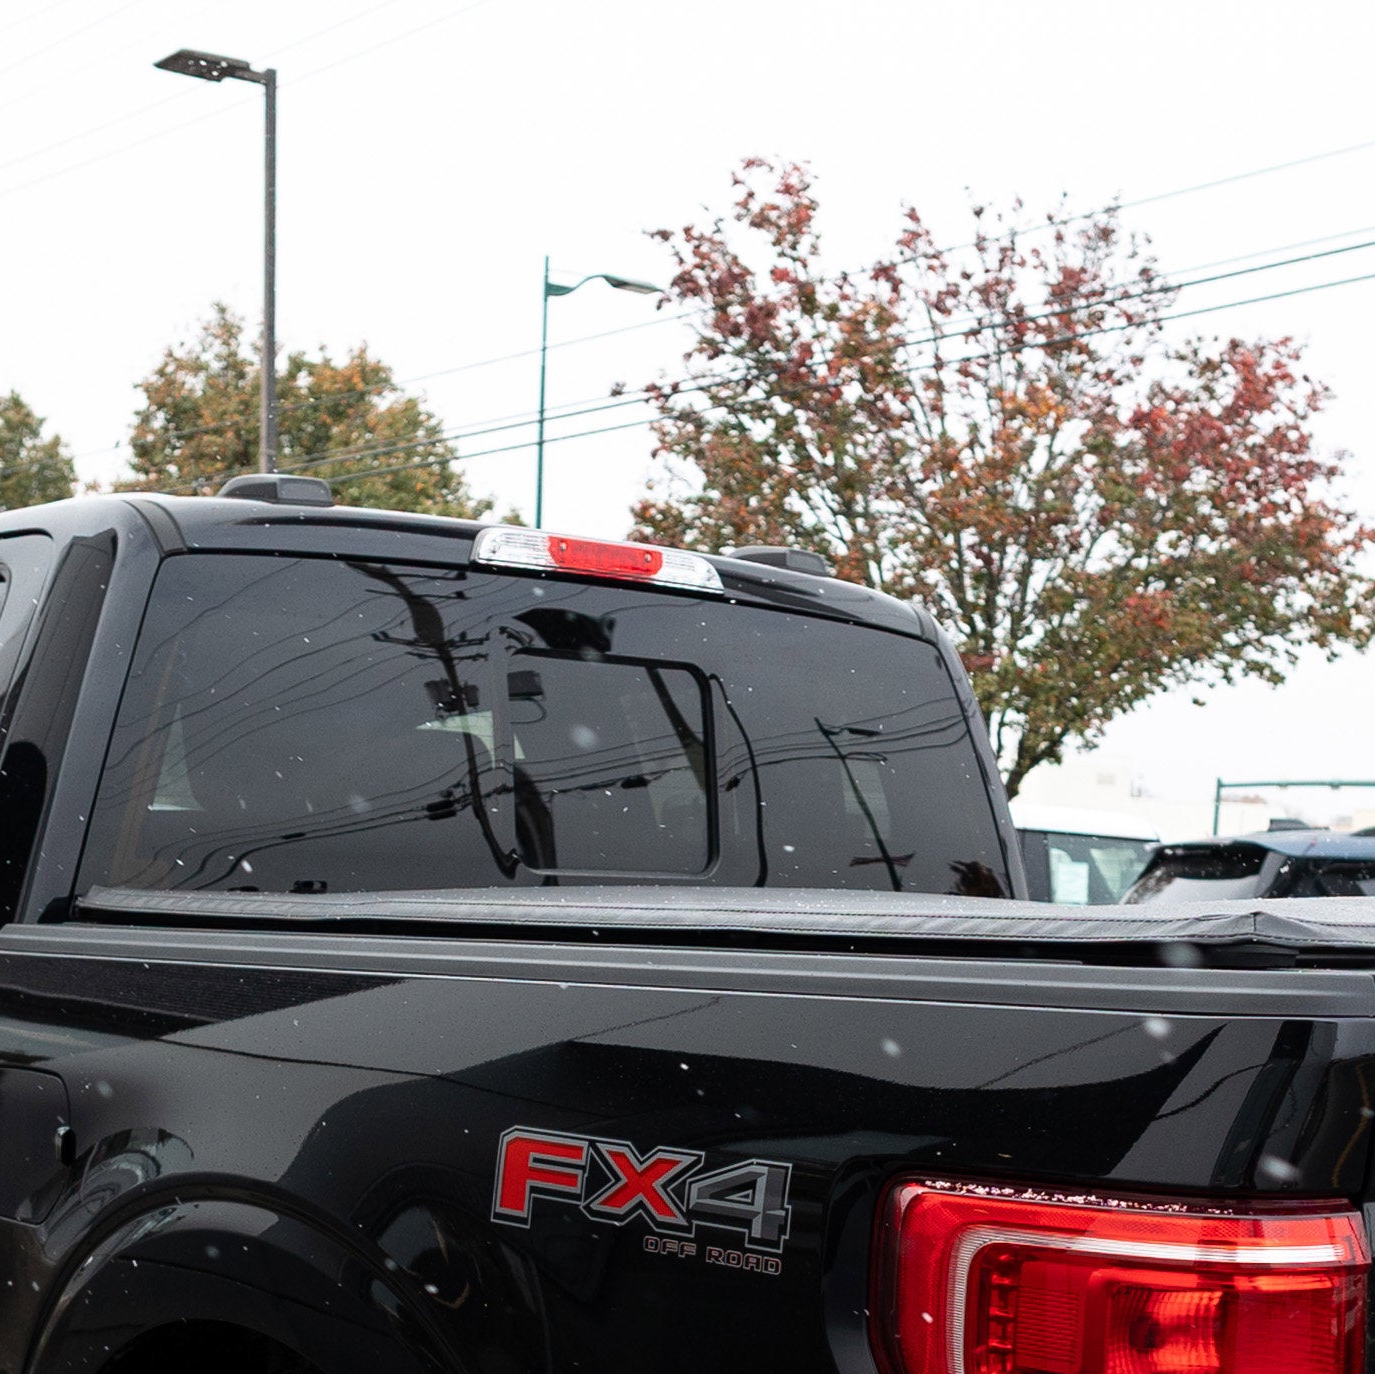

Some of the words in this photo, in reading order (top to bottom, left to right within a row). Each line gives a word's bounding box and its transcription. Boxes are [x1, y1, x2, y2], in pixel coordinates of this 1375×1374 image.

[491, 1125, 793, 1253] FX4
[643, 1235, 696, 1257] OFF
[705, 1246, 783, 1276] ROAD
